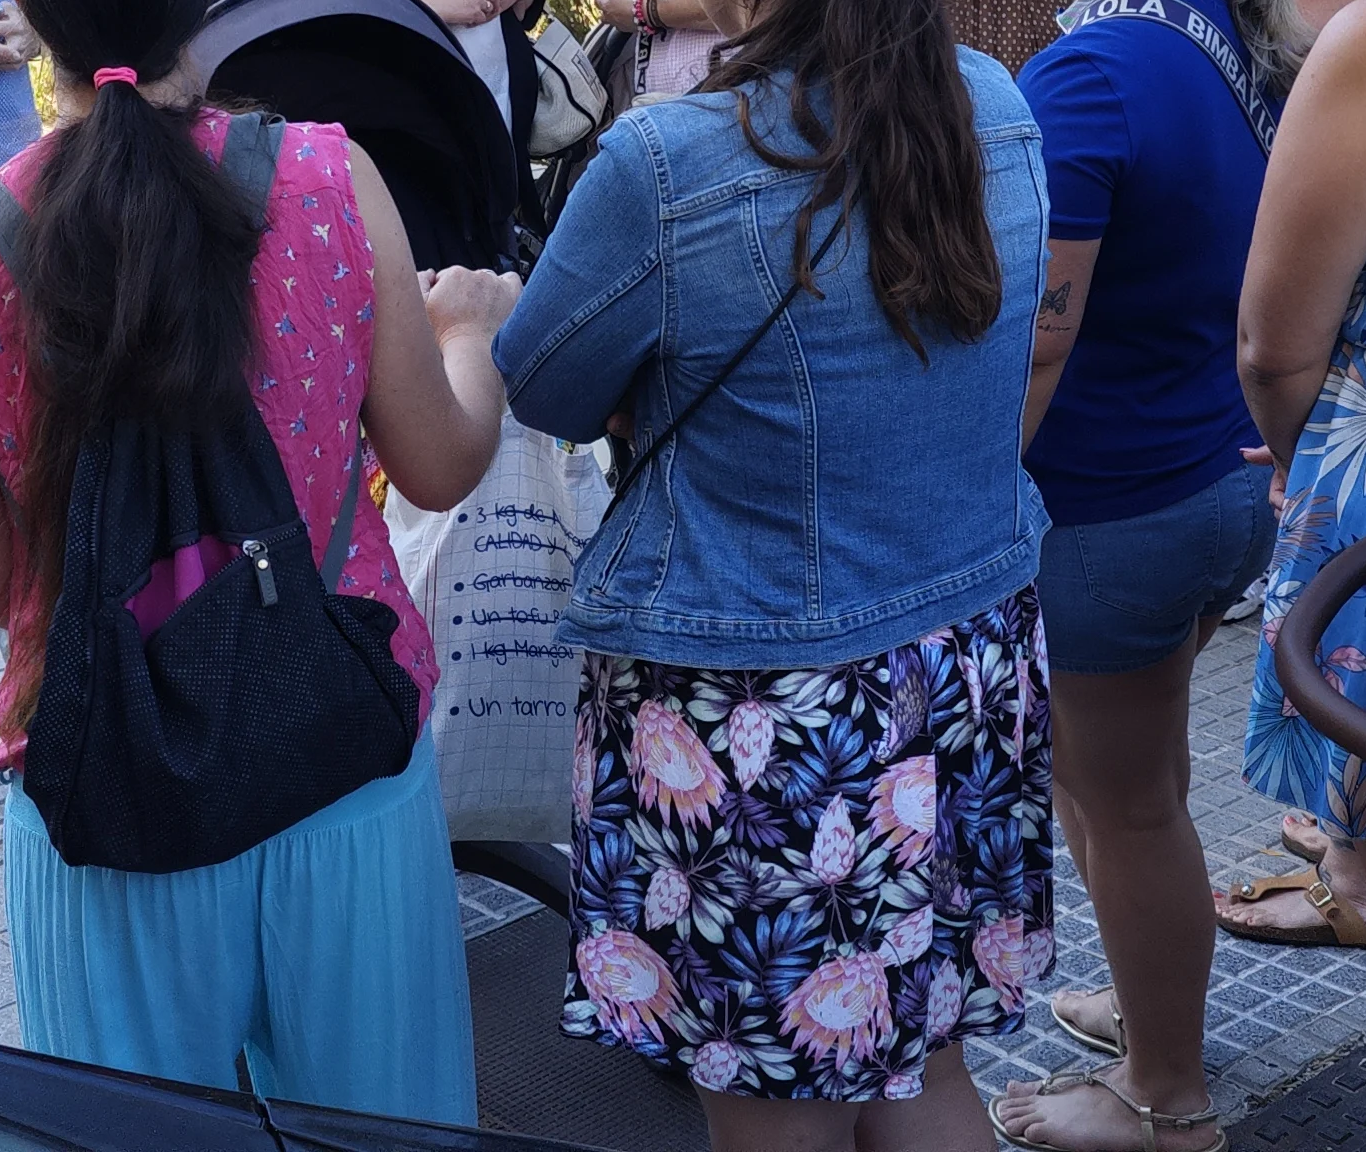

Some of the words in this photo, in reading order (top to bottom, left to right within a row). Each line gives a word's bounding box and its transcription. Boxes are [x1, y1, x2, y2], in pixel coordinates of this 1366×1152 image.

[476, 507, 486, 523] 3
[495, 503, 517, 527] kg
[524, 504, 545, 522] de
[475, 532, 542, 552] CALIDAD
[471, 608, 501, 625] Un
[508, 607, 549, 624] tofu
[484, 641, 507, 665] kg
[468, 697, 502, 717] Un
[511, 696, 567, 716] tarro
